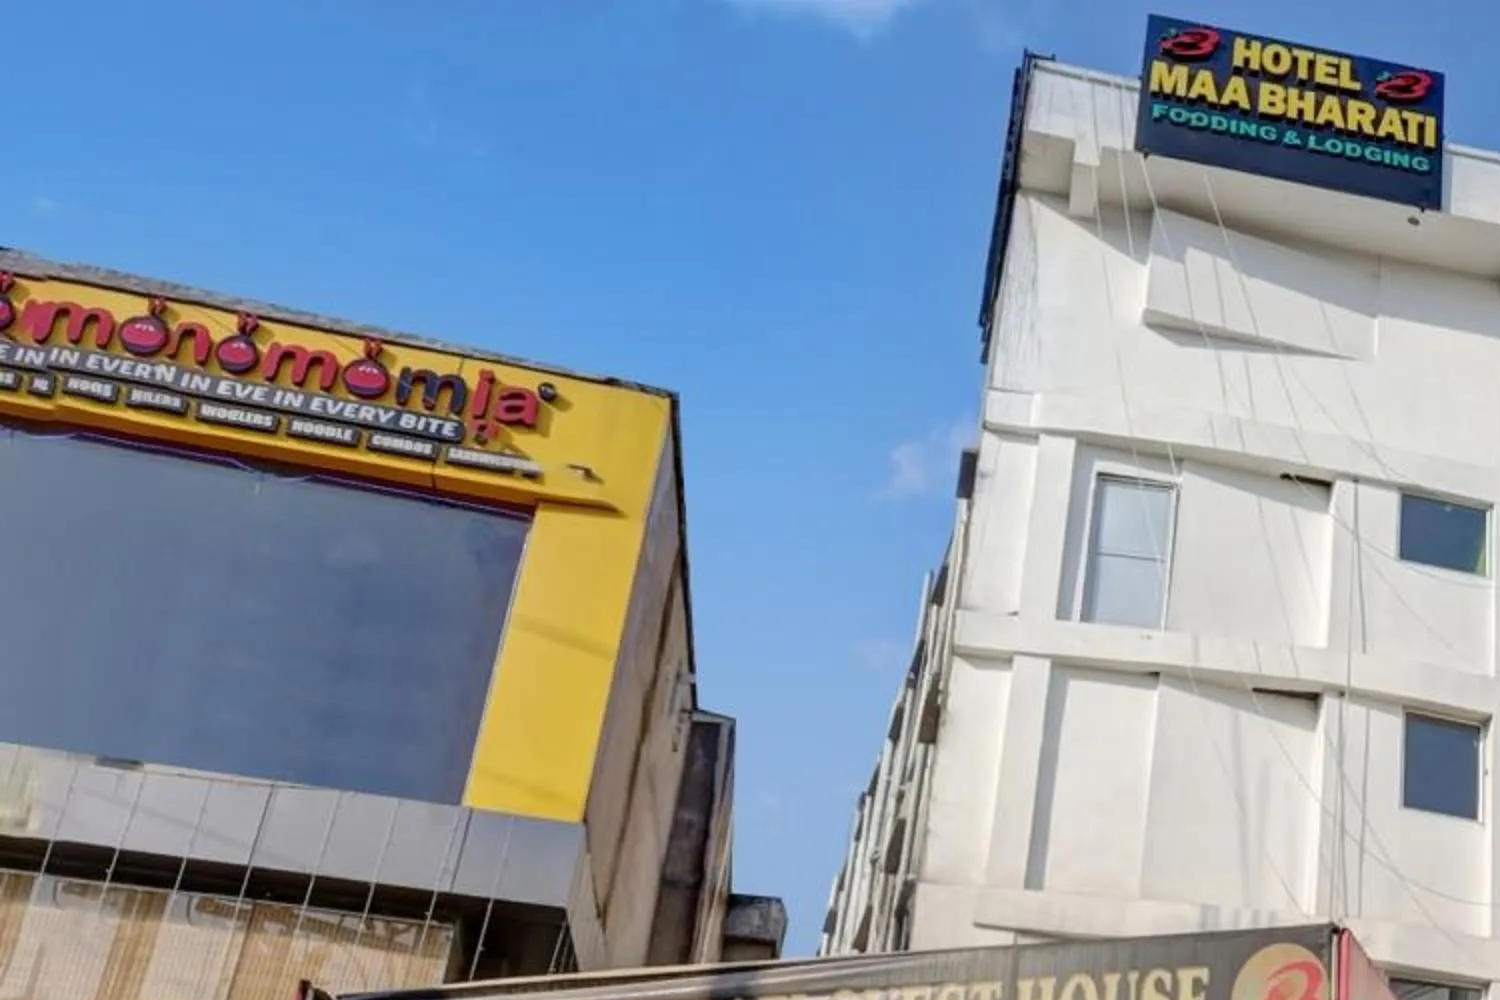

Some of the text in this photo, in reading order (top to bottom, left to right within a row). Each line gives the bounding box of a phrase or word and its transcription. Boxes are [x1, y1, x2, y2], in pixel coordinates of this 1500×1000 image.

[1232, 36, 1361, 92] HOTEL
[1150, 60, 1437, 148] MAA BHARATI
[1151, 103, 1431, 172] FOODING & LODGING
[310, 395, 396, 423] EVERY
[399, 414, 457, 437] BITE
